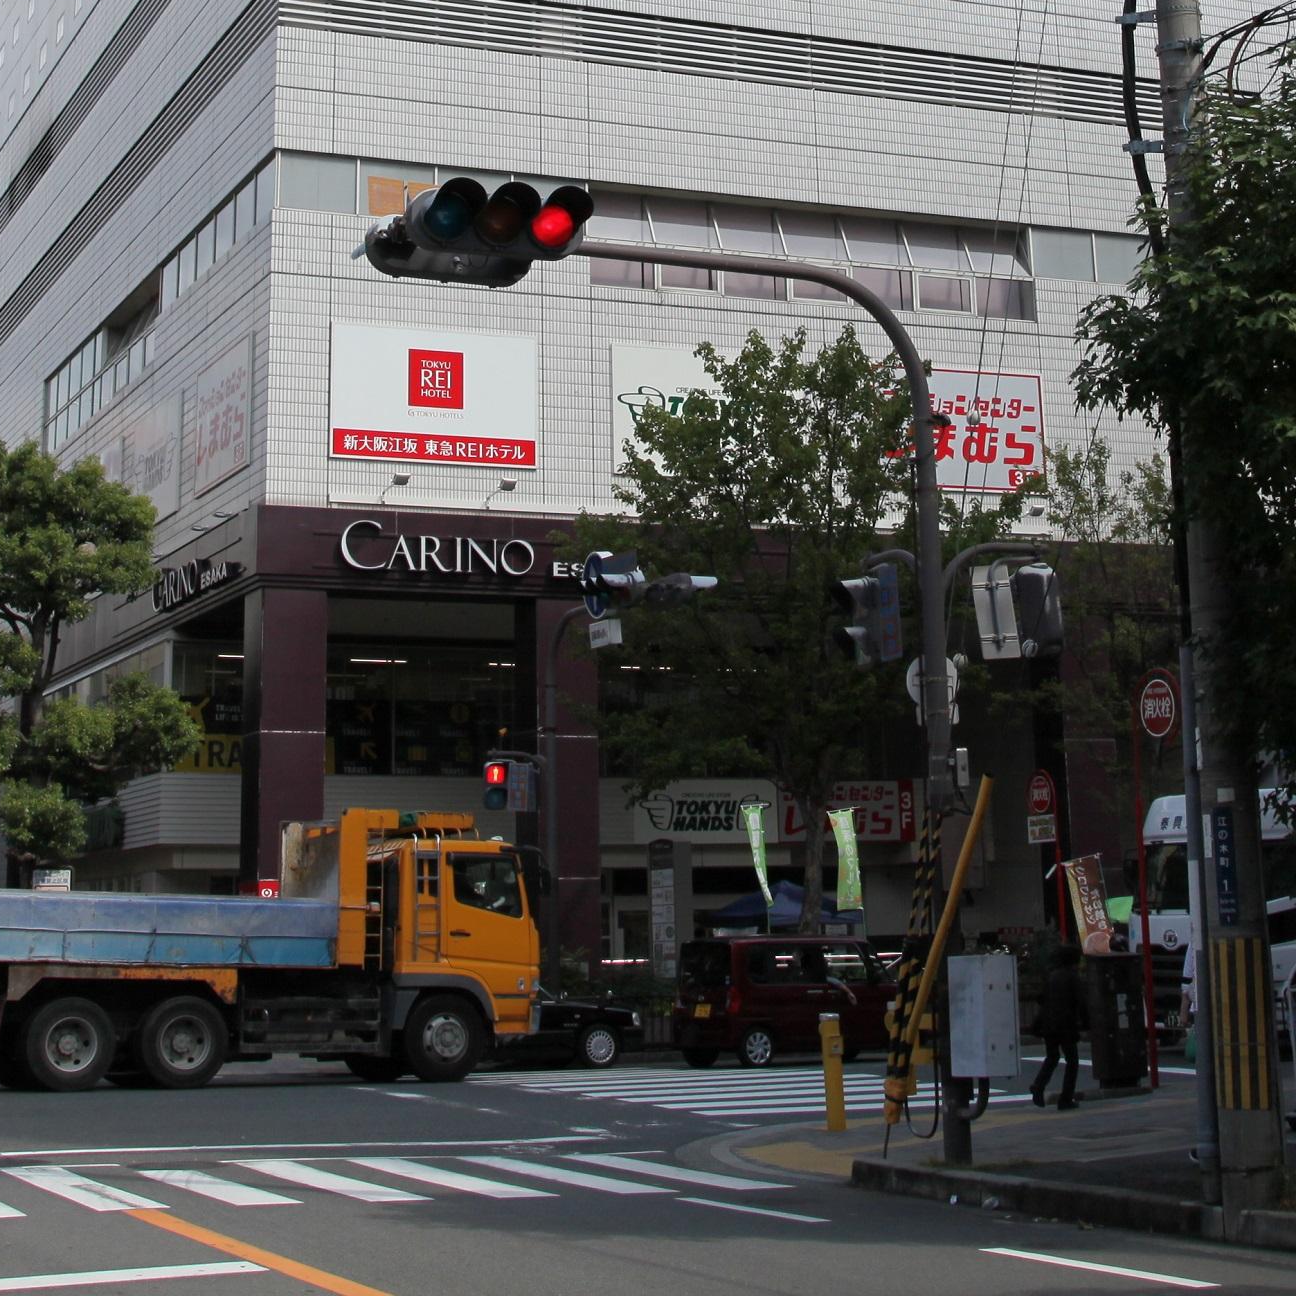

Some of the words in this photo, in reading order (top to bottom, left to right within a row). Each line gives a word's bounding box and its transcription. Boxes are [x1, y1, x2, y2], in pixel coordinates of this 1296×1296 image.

[420, 360, 452, 371] TOKYU
[420, 370, 452, 389] REI
[421, 388, 452, 400] HOTEL
[437, 412, 464, 420] HOTELS
[343, 434, 419, 455] 新大阪江坂
[424, 439, 526, 461] 東急REIホテル
[341, 519, 535, 576] CARINO
[151, 559, 200, 613] CARINO
[200, 563, 228, 588] ESAKA
[1144, 696, 1172, 719] 消火栓
[676, 800, 737, 815] TOKYU
[901, 791, 913, 828] 3F
[673, 815, 734, 832] HANDS
